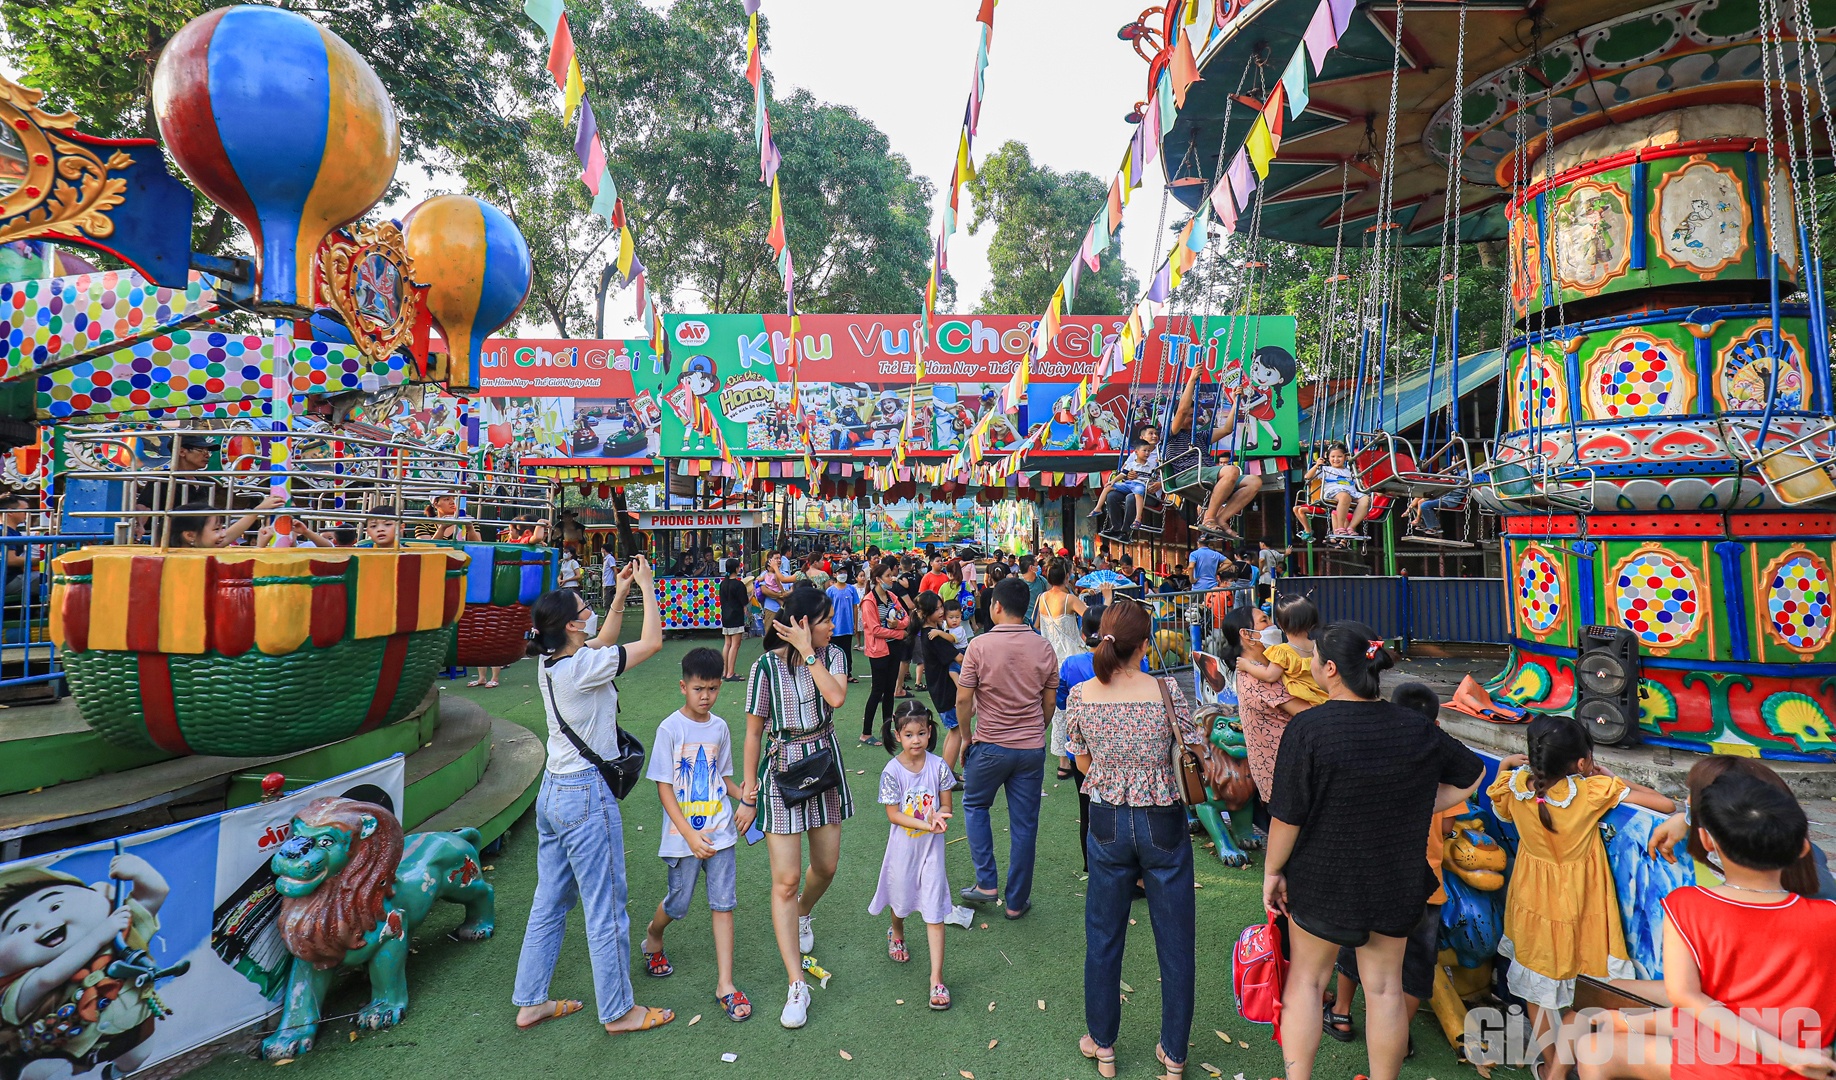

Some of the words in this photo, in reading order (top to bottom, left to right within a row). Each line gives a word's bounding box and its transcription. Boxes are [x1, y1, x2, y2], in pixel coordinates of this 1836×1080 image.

[738, 331, 832, 368] Khu
[848, 320, 925, 357] Vui
[1159, 328, 1226, 371] Trí
[481, 346, 508, 368] ui
[585, 347, 641, 372] Giải
[878, 360, 899, 374] Trẻ
[923, 360, 951, 374] Hôm
[953, 361, 979, 377] Nay
[989, 359, 1012, 375] Thế
[1038, 361, 1072, 377] Ngày
[480, 378, 494, 387] Em
[494, 377, 512, 387] Hôm
[513, 378, 530, 388] Nay
[565, 377, 585, 388] Ngày
[584, 378, 601, 387] Mai
[718, 386, 775, 416] Handy
[651, 513, 693, 526] PHÒNG
[697, 512, 723, 525] BÁN
[726, 512, 741, 525] VÉ
